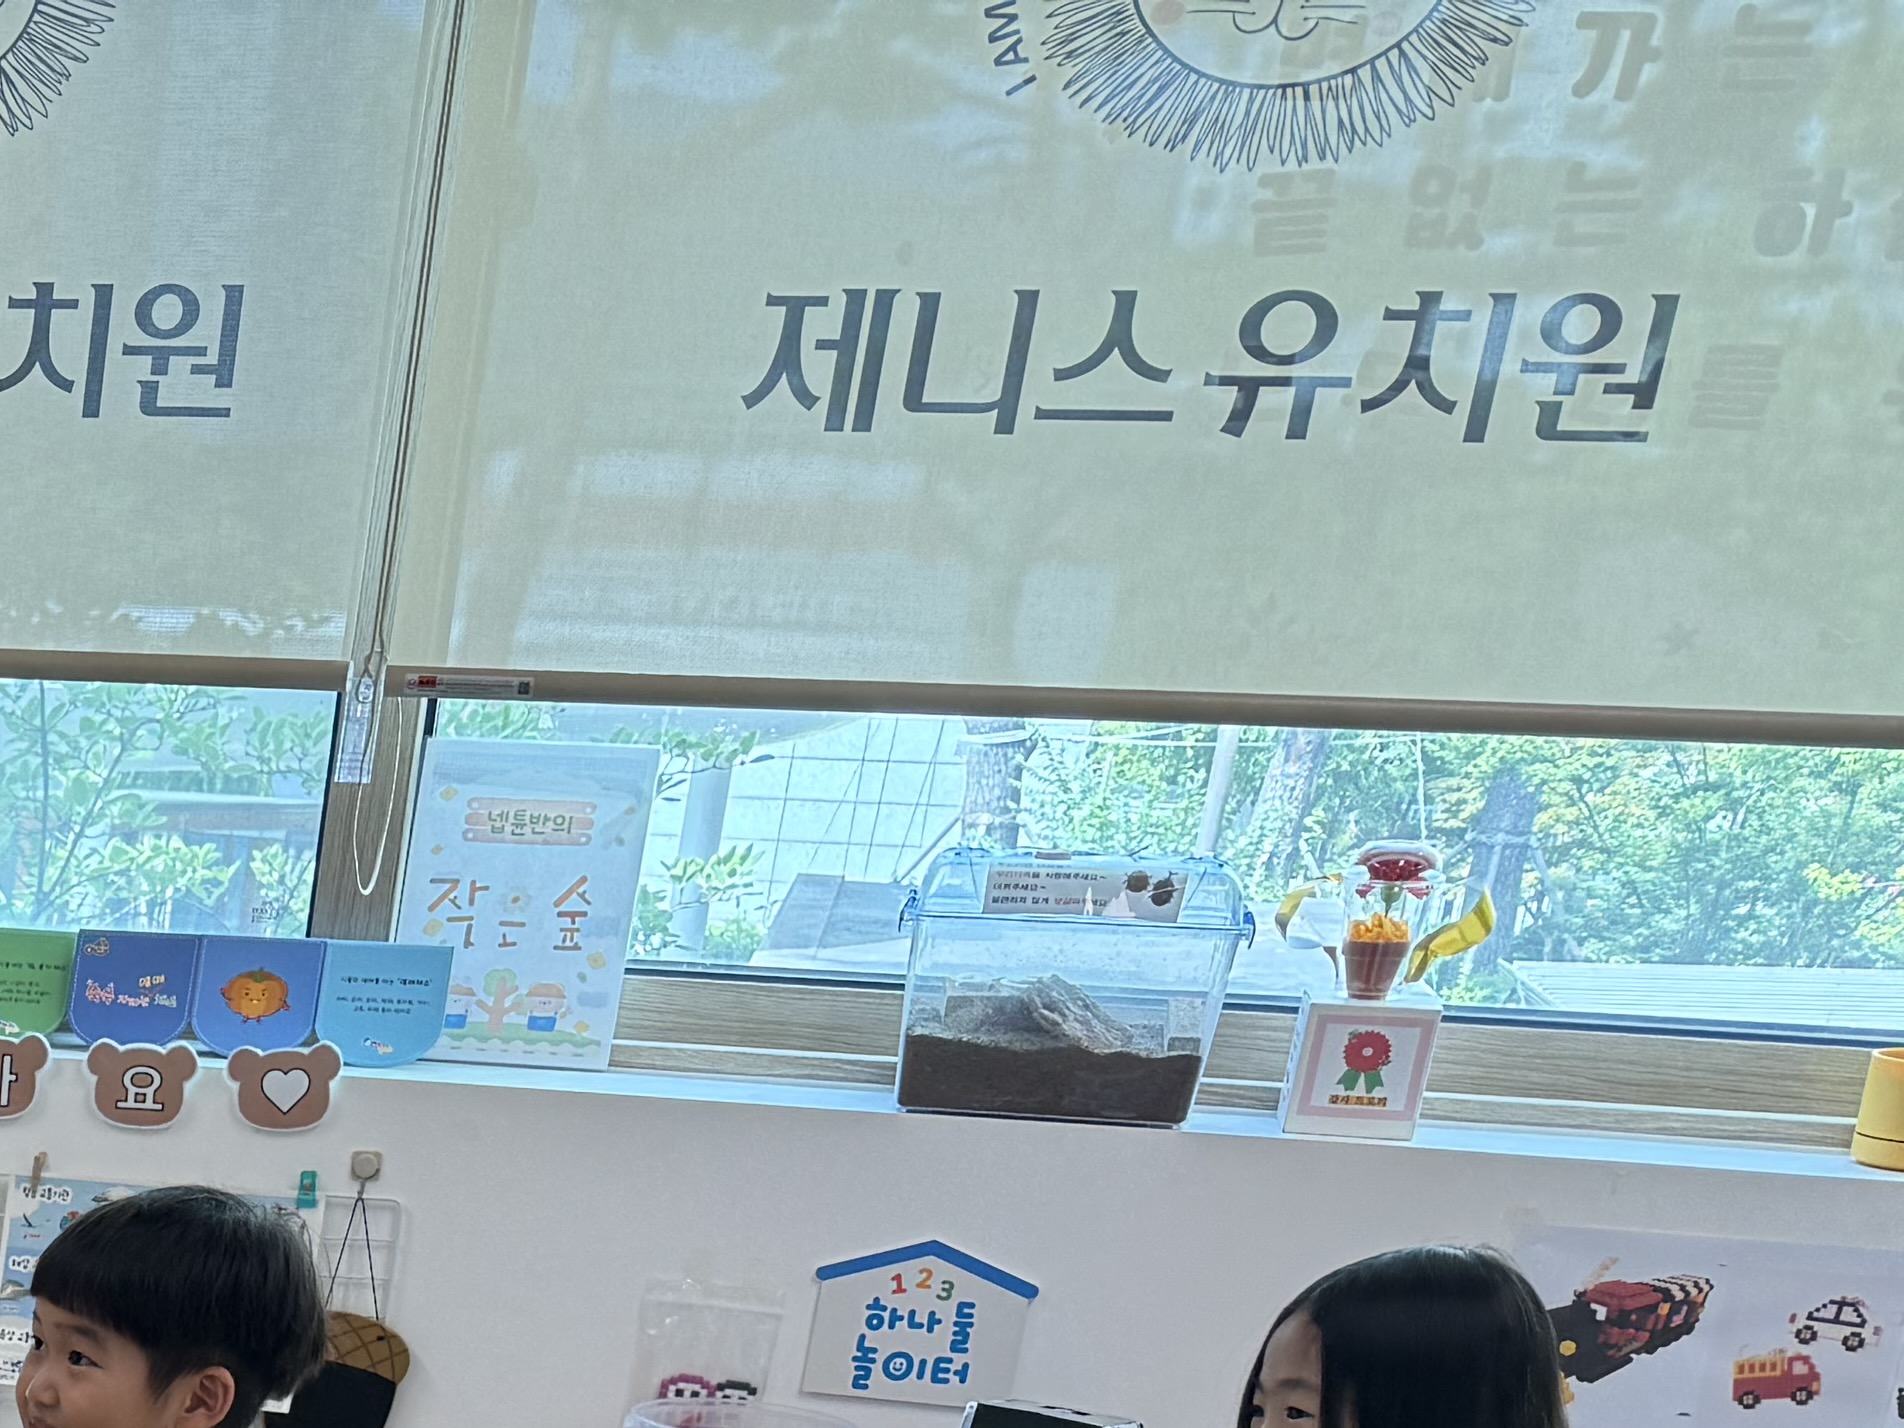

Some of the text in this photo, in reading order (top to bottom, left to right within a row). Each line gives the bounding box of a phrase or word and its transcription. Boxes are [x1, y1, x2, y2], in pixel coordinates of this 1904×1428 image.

[489, 808, 574, 836] 넵튠반의
[890, 1267, 955, 1301] 1 2 3
[851, 1333, 970, 1391] 놀이터
